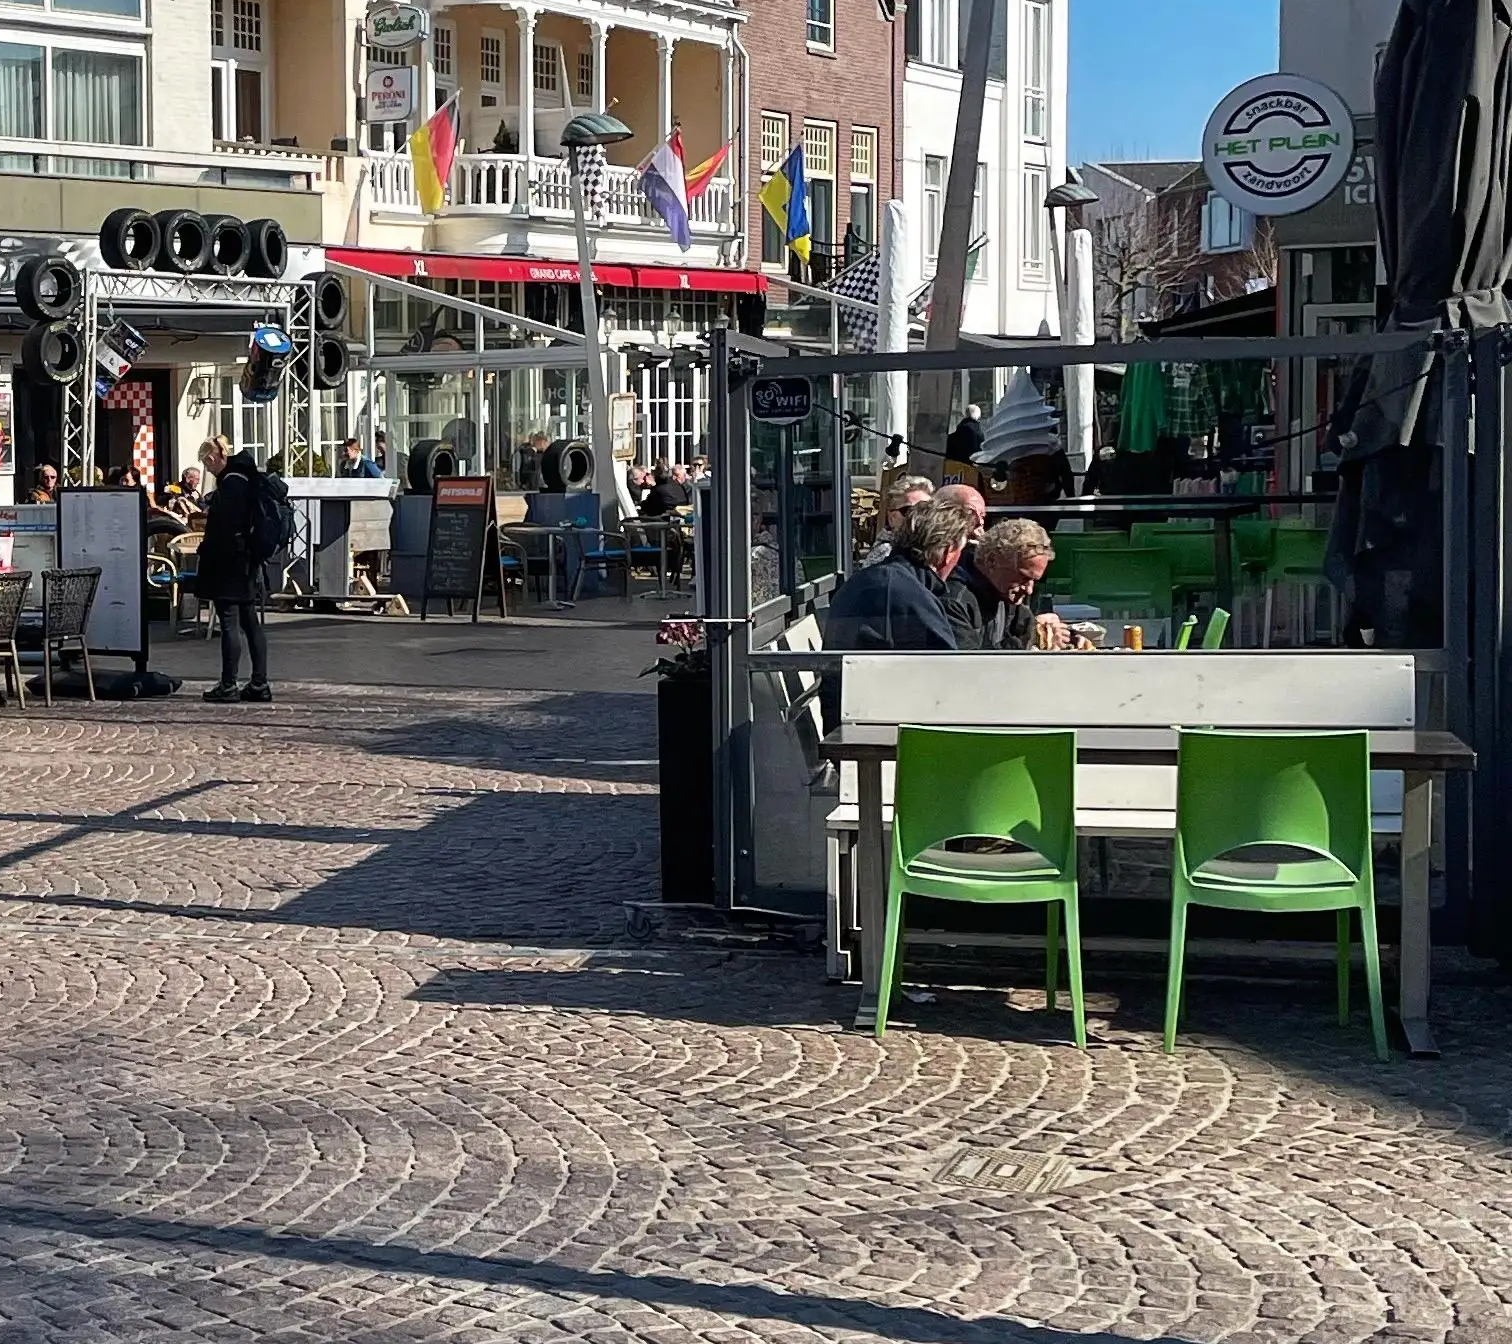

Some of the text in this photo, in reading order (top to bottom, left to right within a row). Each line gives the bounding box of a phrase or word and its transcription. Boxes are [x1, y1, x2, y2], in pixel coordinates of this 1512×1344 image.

[1245, 98, 1308, 120] snackbar
[1214, 132, 1340, 157] HET PLEIN
[1242, 166, 1312, 190] zandvoort
[413, 259, 428, 277] XL
[775, 395, 808, 407] WIFI
